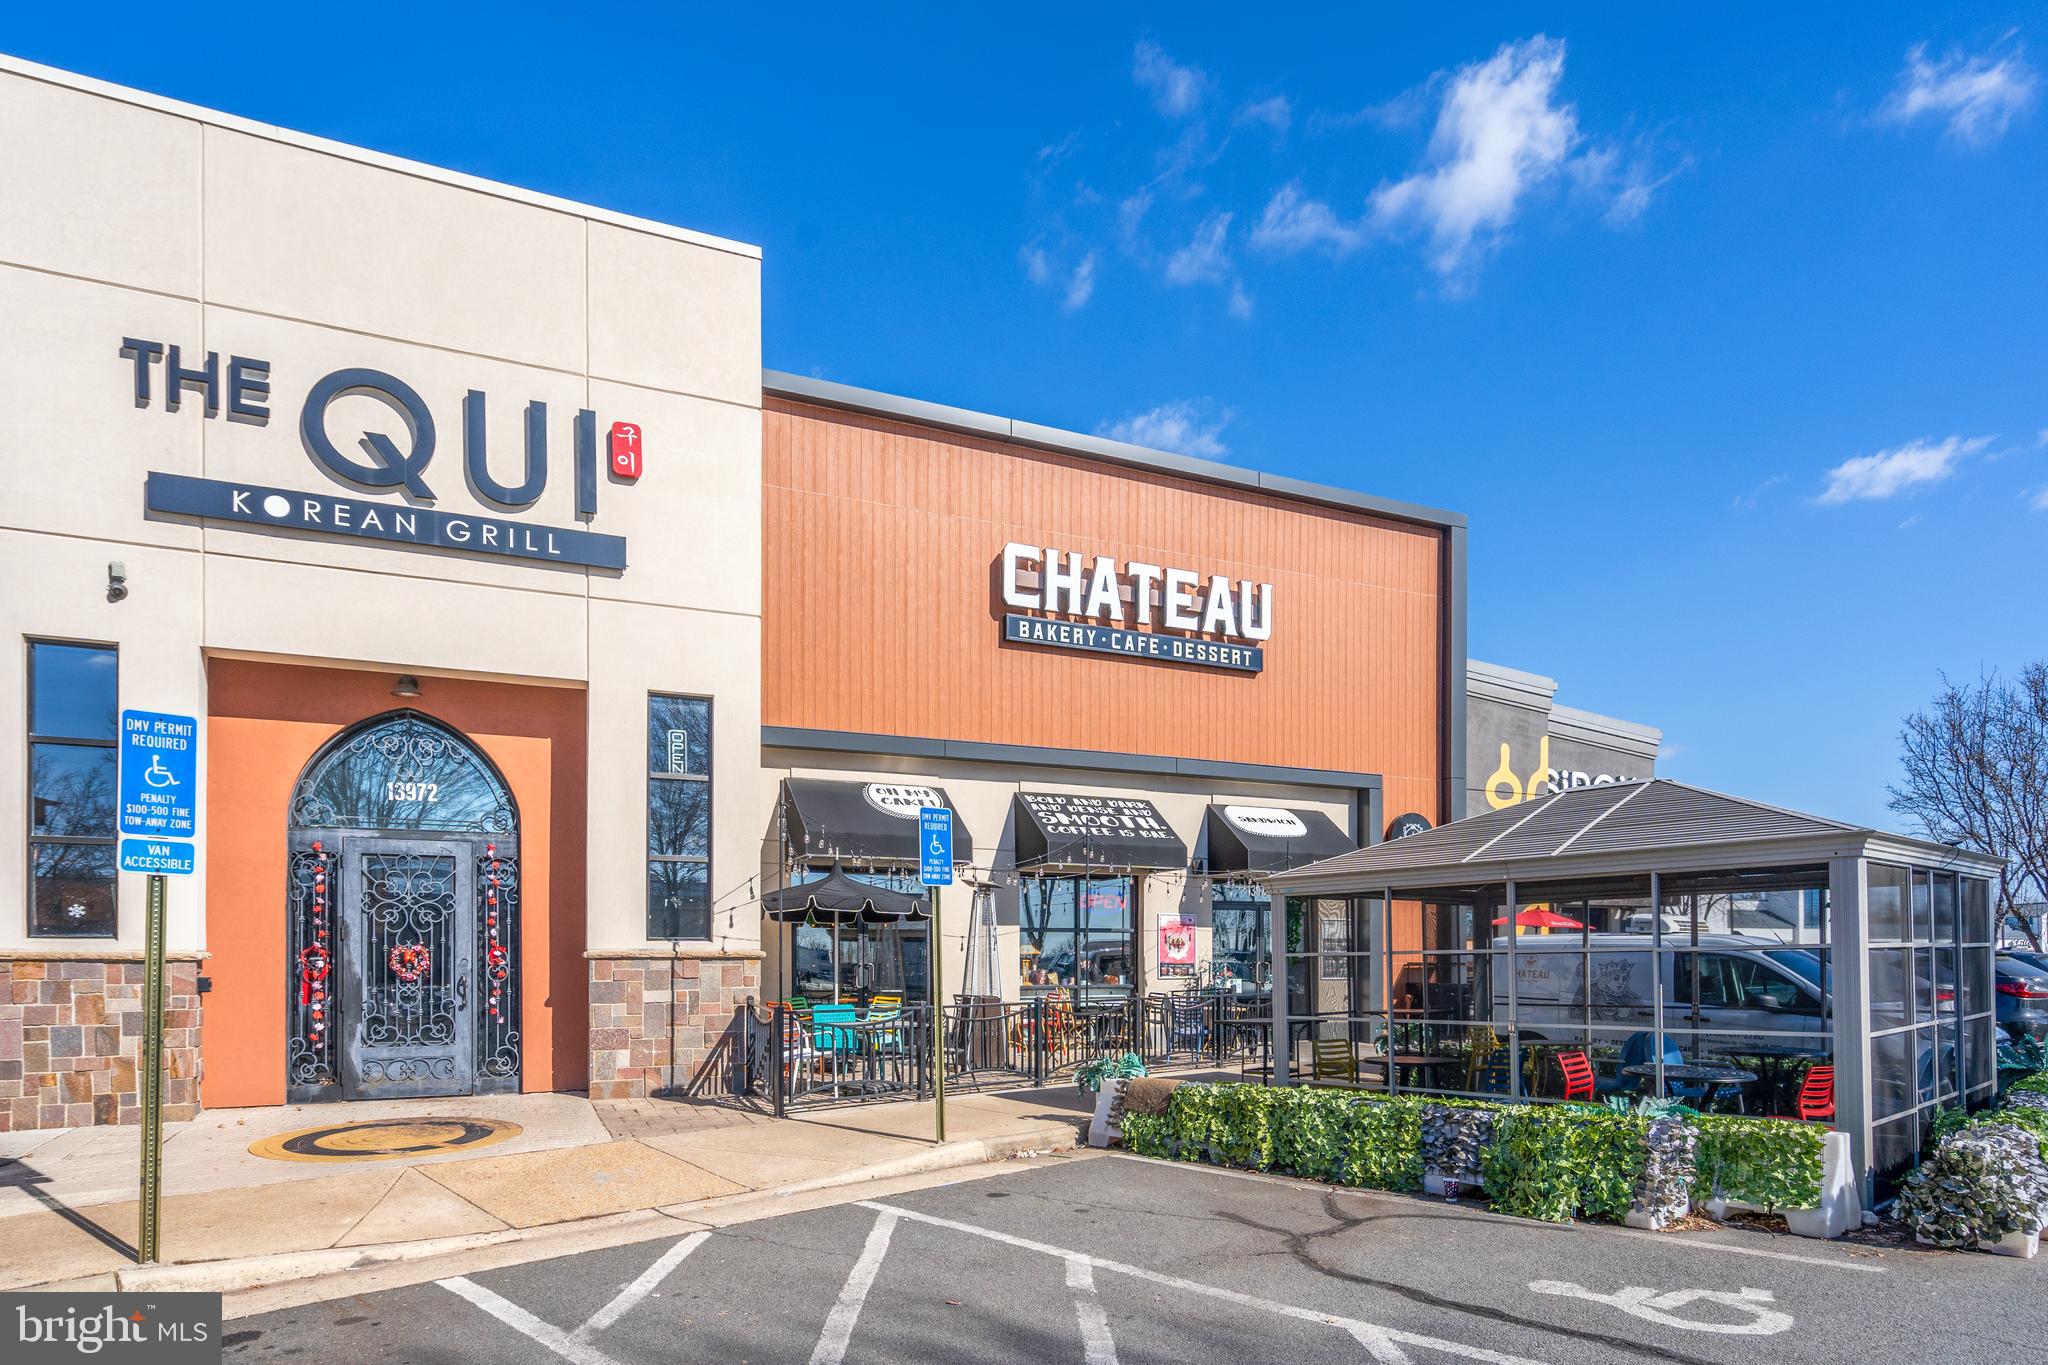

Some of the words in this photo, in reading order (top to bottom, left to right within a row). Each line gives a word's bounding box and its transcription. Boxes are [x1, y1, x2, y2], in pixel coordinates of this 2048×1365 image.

[121, 337, 270, 420] THE
[300, 367, 597, 514] QUI
[616, 426, 638, 473] 구이
[232, 490, 415, 535] KOREAN
[446, 520, 561, 554] GRILL
[1002, 542, 1272, 640] CHATEAU
[1019, 620, 1097, 647] BAKERY
[1111, 633, 1159, 655] CAFE
[1173, 641, 1252, 667] DESSERT
[126, 718, 149, 732] DMV
[154, 721, 193, 737] PERMIT
[132, 734, 187, 751] REQUIRED
[671, 732, 684, 774] OPEN
[140, 793, 176, 805] PENALTY
[387, 782, 438, 801] 13972
[1024, 794, 1066, 804] BOLD
[1073, 797, 1102, 807] AND
[1110, 800, 1150, 809] DARK
[126, 804, 169, 816] $100-500
[172, 806, 190, 818] FINE
[1030, 803, 1061, 812] AND
[1067, 805, 1119, 815] DENSE
[1124, 808, 1152, 816] AND
[124, 815, 167, 828] TOW-AWAY
[170, 817, 192, 829] ZONE
[933, 814, 949, 822] PERMIT
[1037, 811, 1168, 830] SMOOTH.
[924, 822, 947, 831] REQUIRED
[1046, 825, 1115, 836] COFFEE
[1119, 829, 1135, 837] IS
[1139, 830, 1175, 839] BAE.
[147, 845, 170, 856] VAN
[124, 856, 192, 870] ACCESSIBLE
[1080, 895, 1127, 909] OPEN
